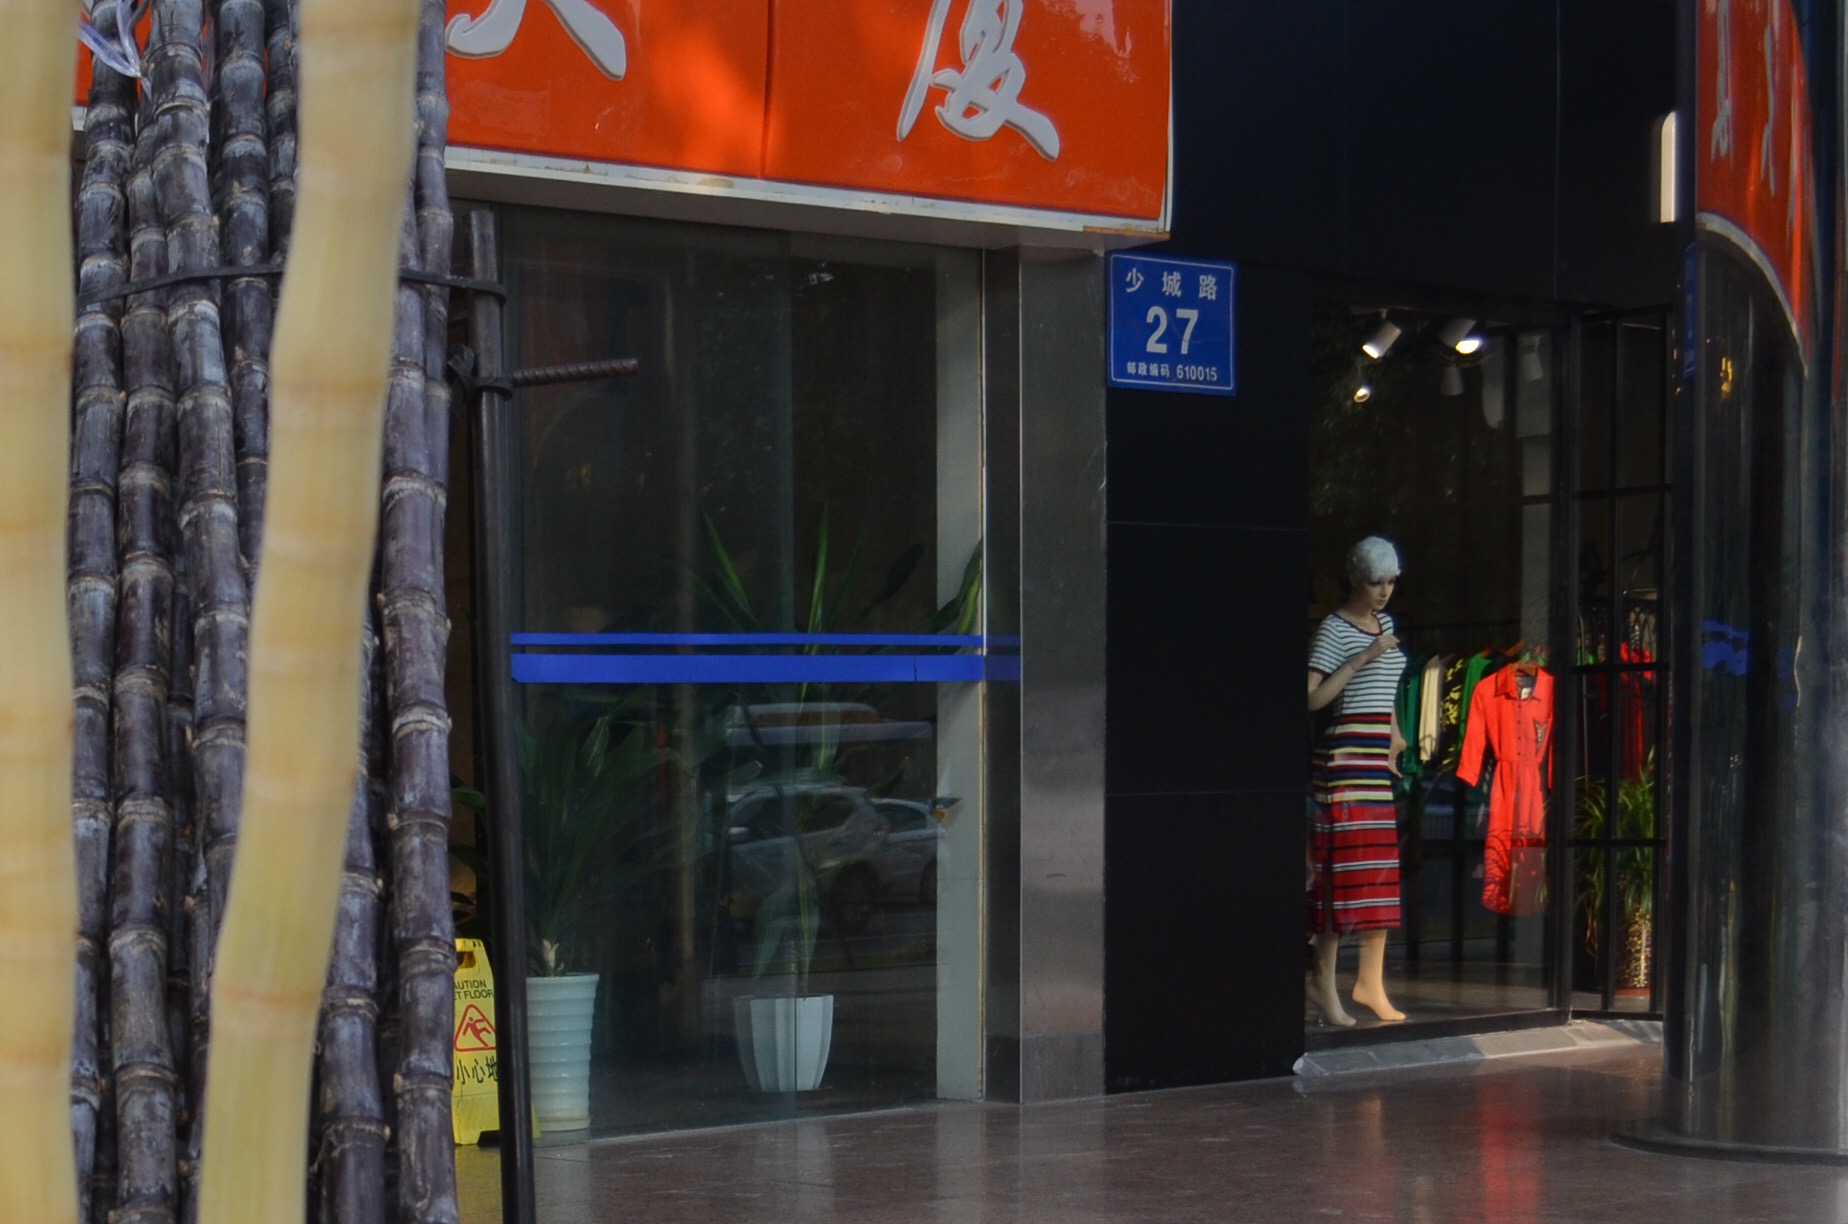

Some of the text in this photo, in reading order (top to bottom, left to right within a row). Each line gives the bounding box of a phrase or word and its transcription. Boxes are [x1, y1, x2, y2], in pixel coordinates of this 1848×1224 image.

[1125, 267, 1217, 301] 少城路
[1145, 305, 1199, 355] 27
[1126, 361, 1218, 382] 邮政编码 610015
